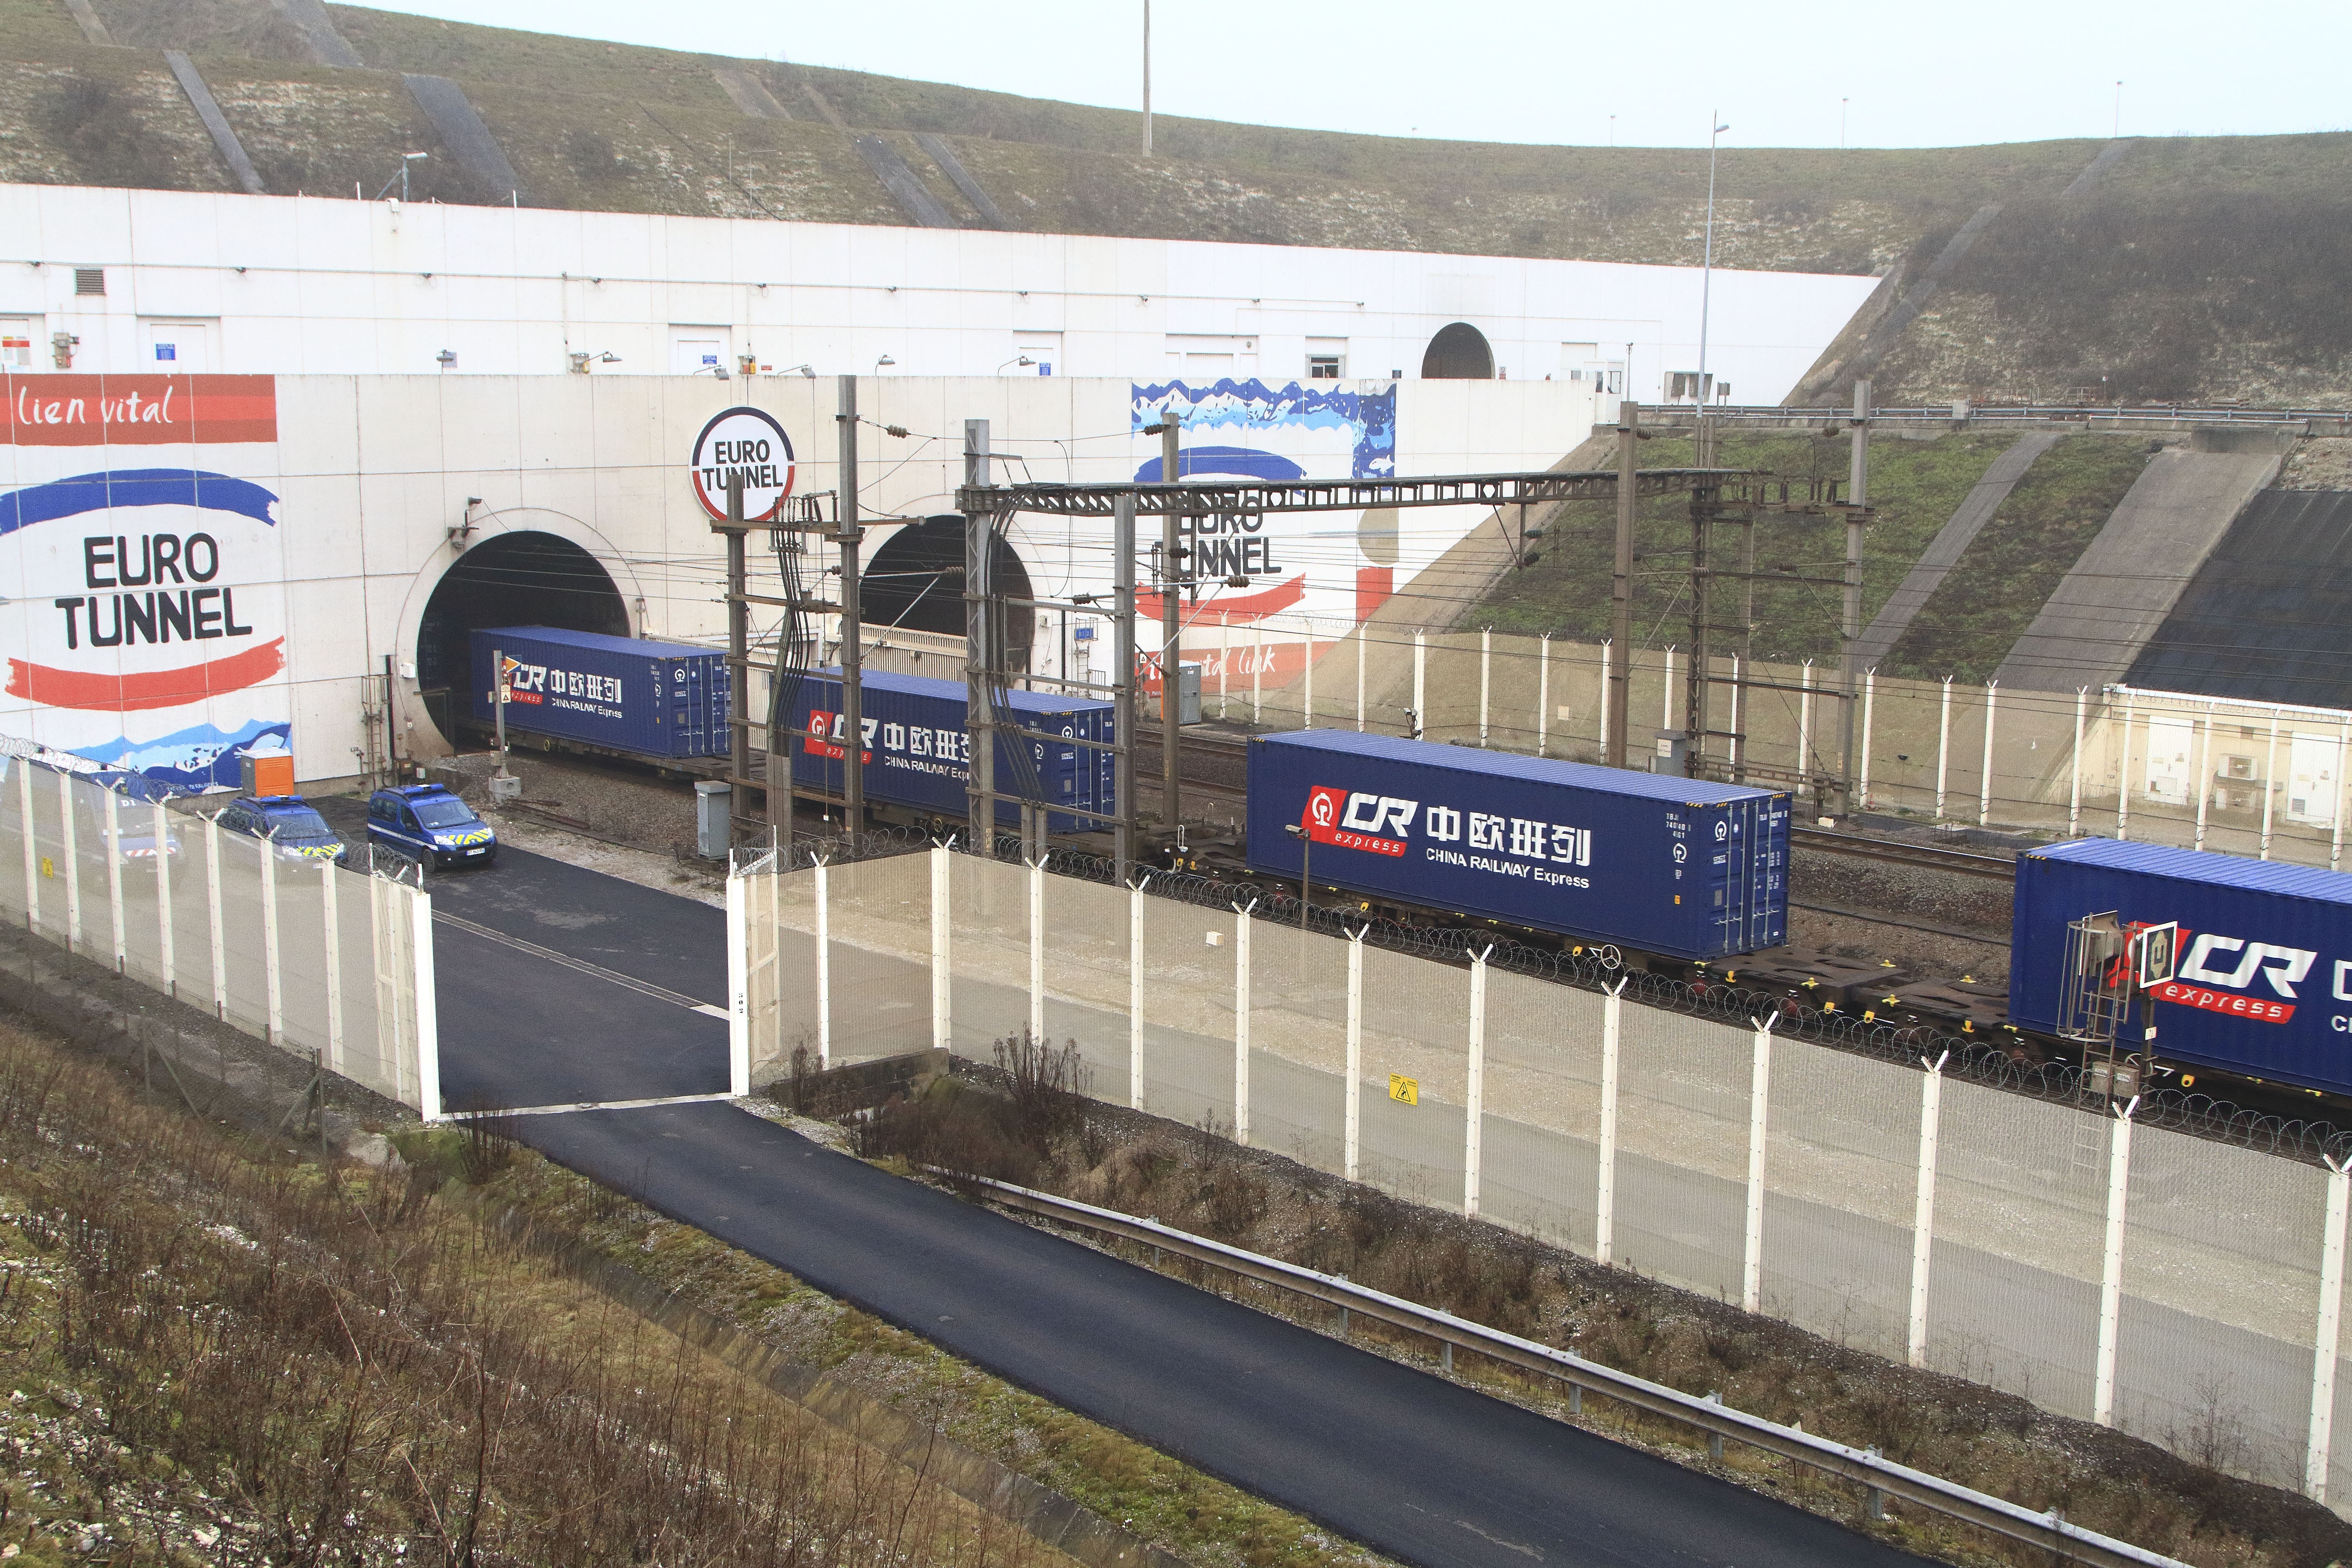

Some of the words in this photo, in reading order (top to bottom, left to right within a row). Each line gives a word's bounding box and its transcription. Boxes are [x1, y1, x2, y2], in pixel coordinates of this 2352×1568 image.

[19, 386, 85, 425] lien
[101, 386, 173, 424] vital
[715, 439, 770, 464] EURO
[84, 533, 219, 589] EURO
[55, 587, 253, 650] TUNNEL
[550, 669, 622, 703] 中欧班列
[885, 756, 910, 769] CHINA
[911, 760, 949, 776] RAILWAY
[1342, 793, 1418, 838] CR
[1335, 833, 1399, 852] express
[1426, 806, 1591, 866] 中欧班列
[1426, 848, 1467, 867] CHINA
[1470, 856, 1531, 878] RAILWAY
[1535, 867, 1590, 888] Express
[2178, 934, 2318, 999] CR
[2165, 985, 2282, 1018] express
